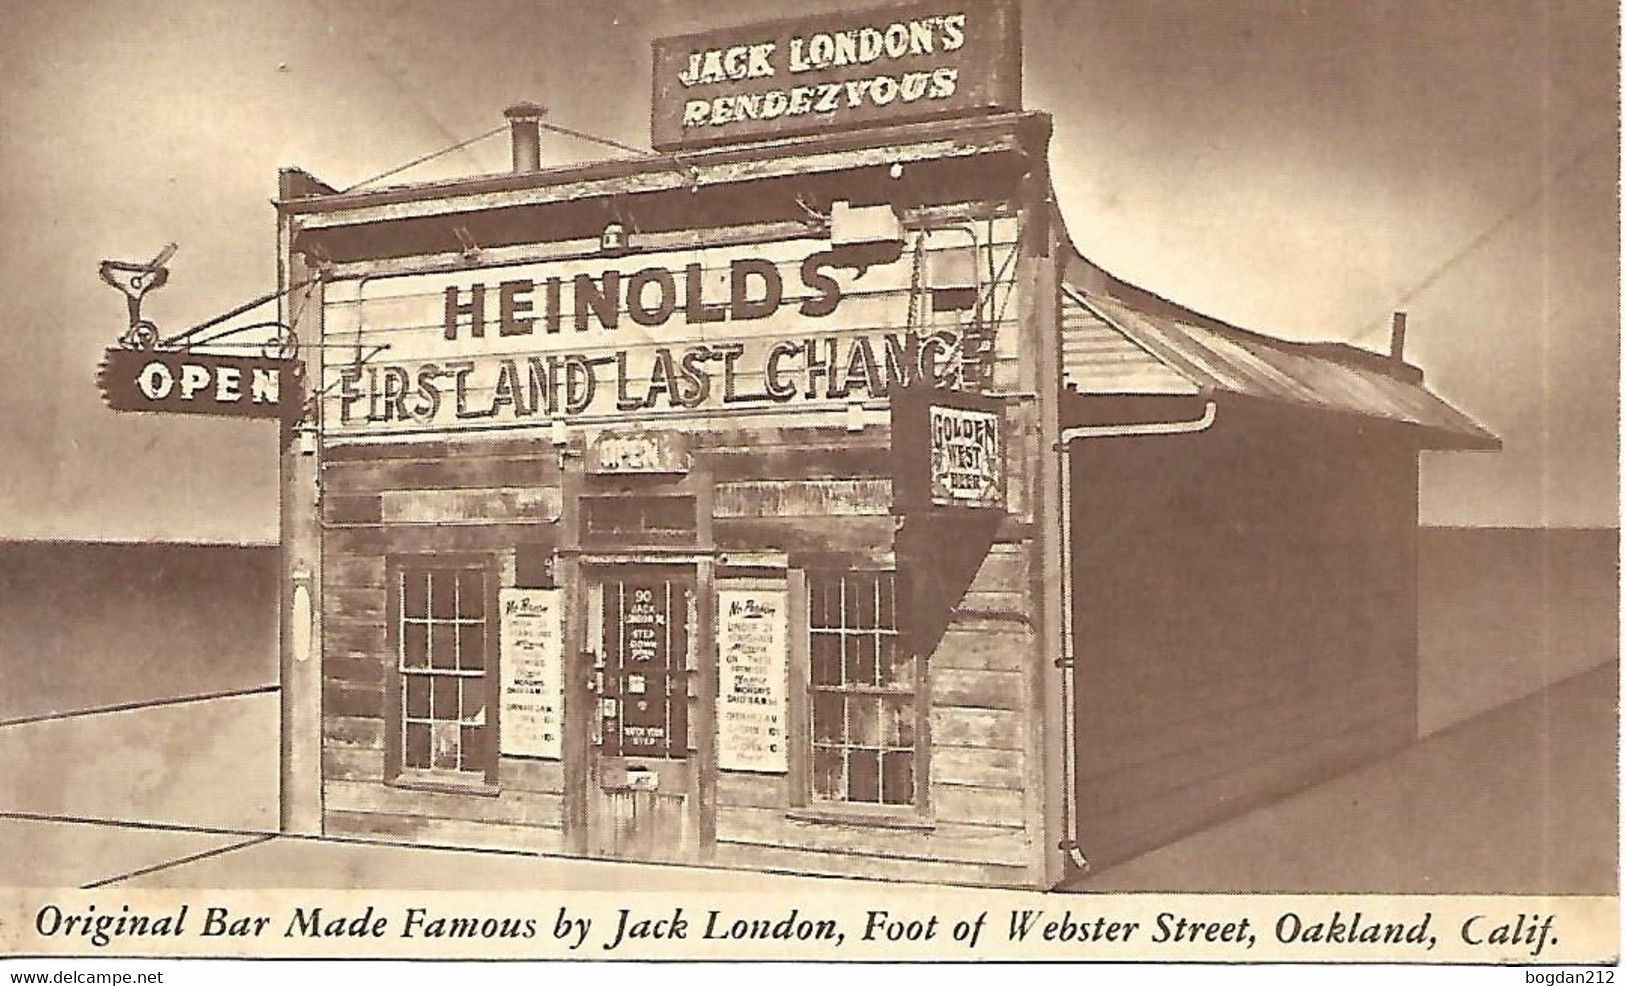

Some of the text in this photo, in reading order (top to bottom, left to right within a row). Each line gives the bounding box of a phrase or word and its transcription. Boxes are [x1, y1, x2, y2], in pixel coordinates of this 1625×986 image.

[677, 13, 967, 87] JACK LONDON'S
[682, 67, 959, 127] RENDEZVOUS
[136, 361, 281, 402] OPEN
[340, 360, 475, 425] FIRST
[492, 353, 597, 418] AND
[616, 345, 744, 410] LAST
[933, 413, 996, 457] GOLDEN
[947, 444, 982, 470] WEST
[635, 590, 653, 603] 90
